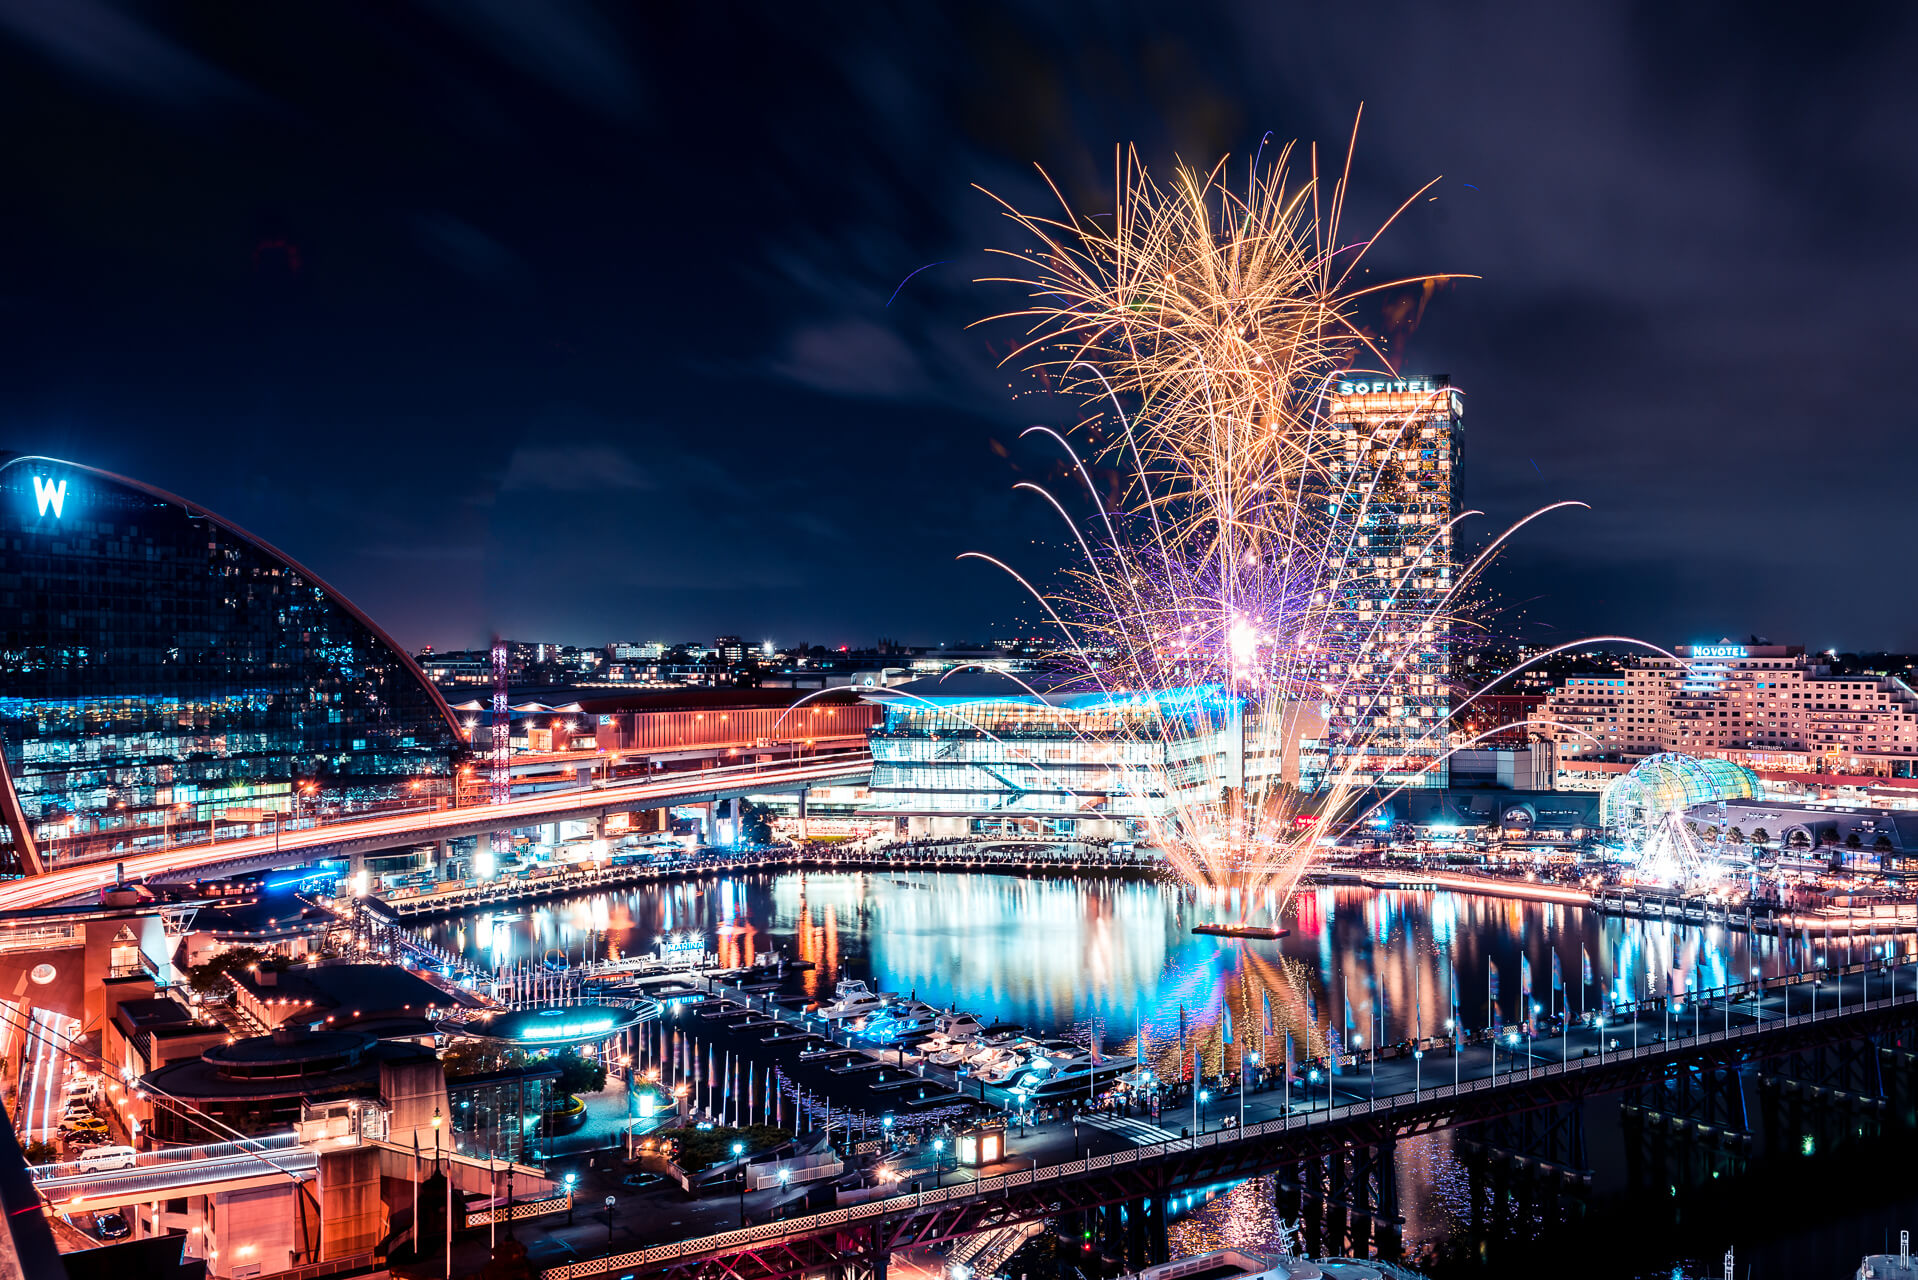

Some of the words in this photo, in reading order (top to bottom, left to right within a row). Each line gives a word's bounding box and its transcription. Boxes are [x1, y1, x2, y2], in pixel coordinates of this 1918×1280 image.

[1340, 381, 1436, 395] SOFITEL
[33, 476, 67, 519] W
[1693, 646, 1748, 657] NOVOTEL
[667, 941, 705, 953] MARINA
